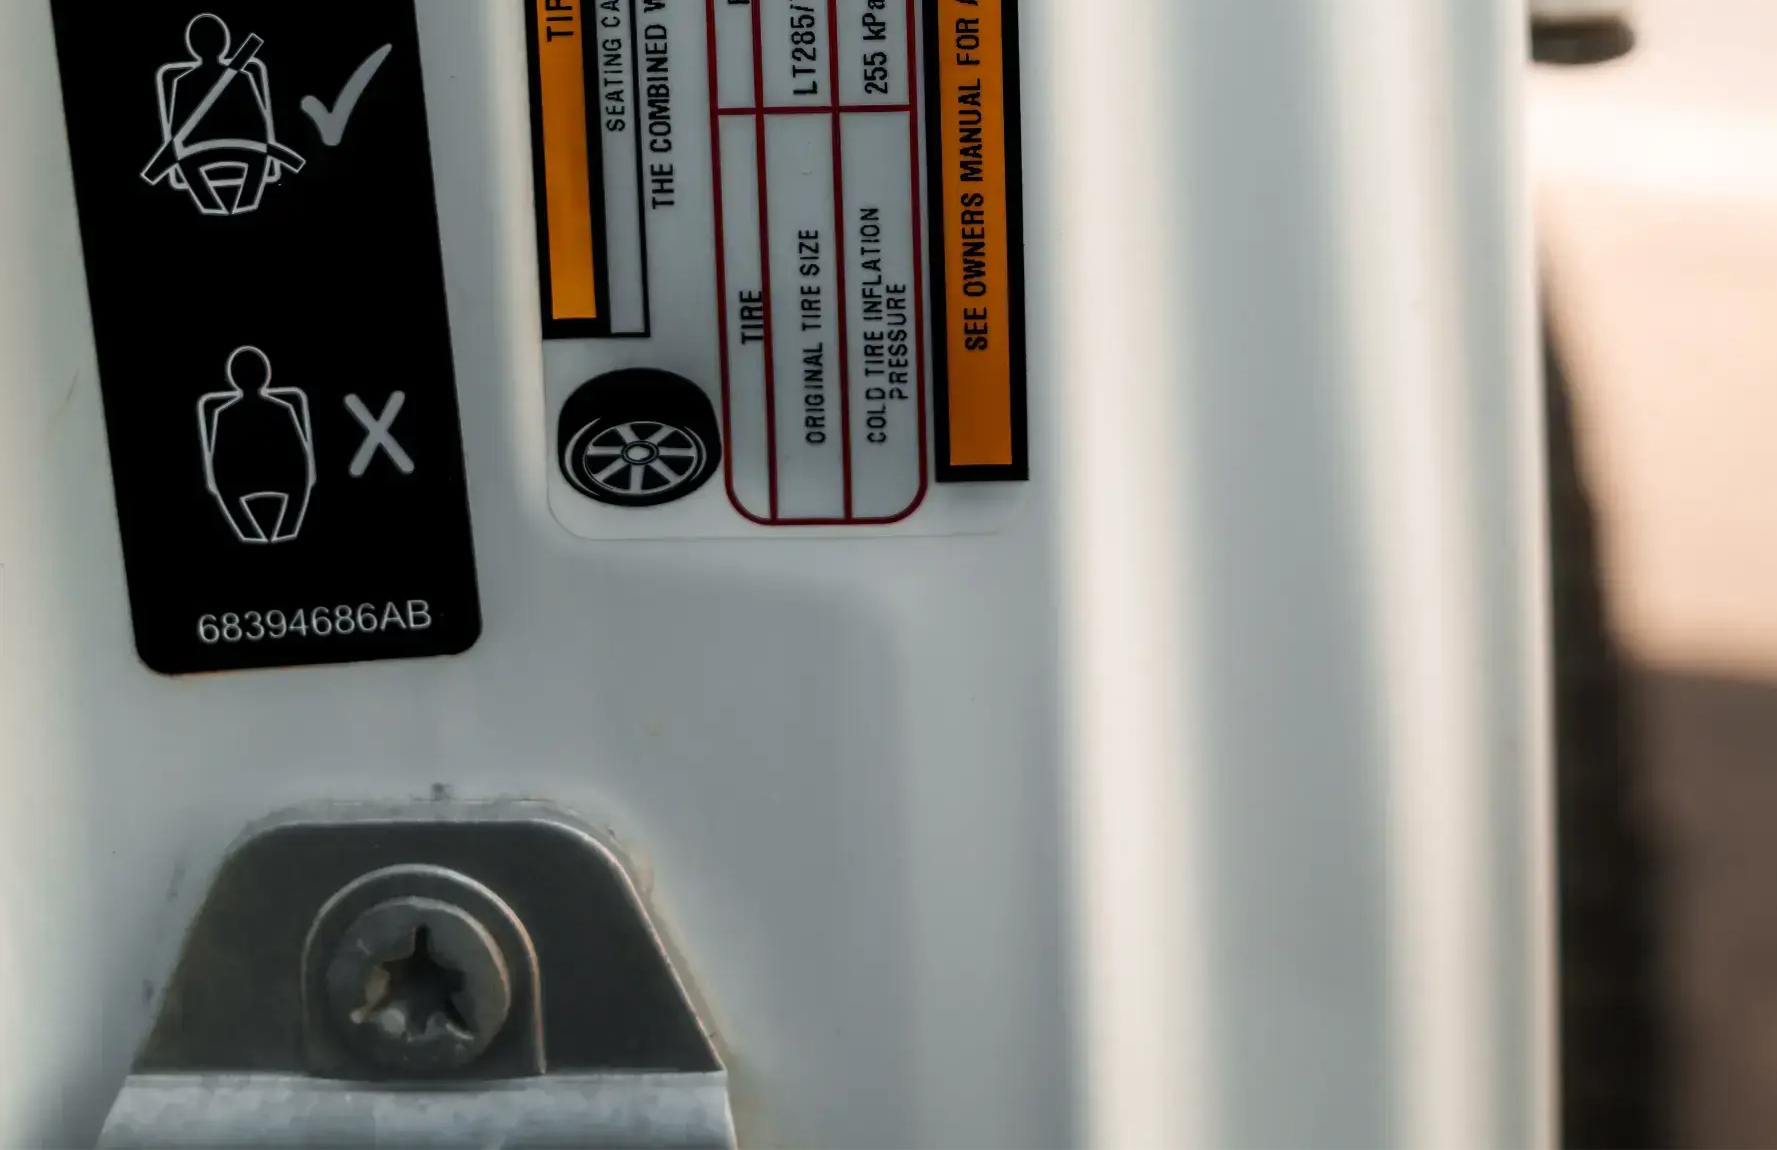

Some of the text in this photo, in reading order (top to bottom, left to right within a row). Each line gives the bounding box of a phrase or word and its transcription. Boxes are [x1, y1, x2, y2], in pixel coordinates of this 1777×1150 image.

[600, 38, 626, 134] SEATING
[644, 24, 672, 153] COMBINED
[862, 51, 889, 95] 255
[955, 17, 979, 65] FOR
[957, 78, 984, 182] MANUAL
[650, 163, 675, 210] THE
[960, 194, 987, 297] OWNERS
[739, 290, 764, 345] TIRE
[797, 229, 827, 445] ORIGINAL TIRE SIZE
[859, 208, 887, 444] COLD TIRE INFLATION
[885, 284, 909, 400] PRESSURE
[963, 309, 988, 351] SEE
[197, 599, 432, 644] 68394686AB
